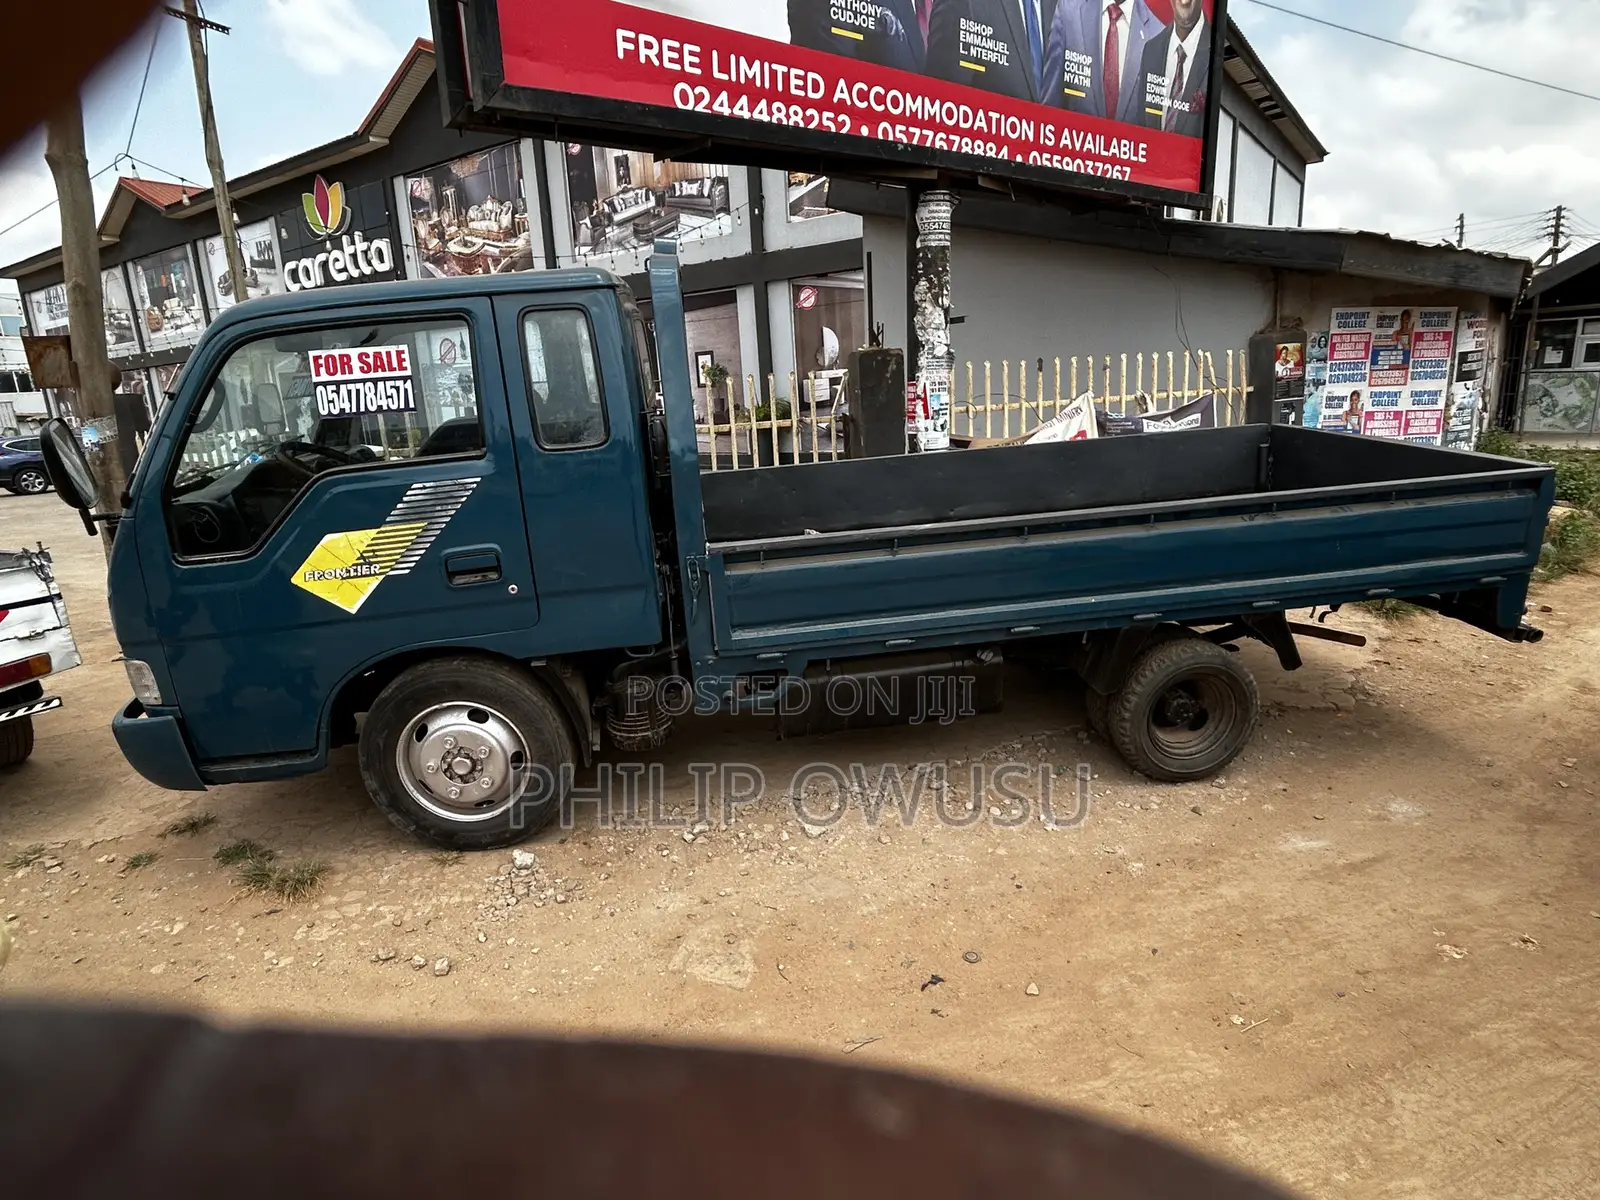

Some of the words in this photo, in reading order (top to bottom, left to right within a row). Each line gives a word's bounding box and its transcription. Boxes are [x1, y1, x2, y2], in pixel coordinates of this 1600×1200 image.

[830, 7, 876, 30] CUDJOE
[960, 18, 993, 37] BISHOP
[960, 31, 1009, 54] EMMANUEL
[960, 42, 968, 55] L.
[970, 46, 1009, 66] NTERFUL
[1065, 49, 1092, 66] BISHOP
[1064, 61, 1091, 77] COLLIN
[1063, 72, 1091, 88] NYATHI
[1147, 73, 1169, 87] BISHOP
[615, 28, 702, 75] FREE
[712, 49, 825, 100] LIMITED
[832, 77, 1034, 142] ACCOMMODATION
[1039, 122, 1056, 145] IS
[1060, 128, 1148, 163] AVAILABLE
[1146, 83, 1166, 96] EDWIN
[673, 82, 851, 135] 0244488252
[1145, 94, 1172, 107] MORGAN
[1336, 312, 1370, 320] ENDPOINT
[1337, 320, 1367, 328] COLLEGE
[1421, 319, 1449, 327] COLLEGE
[312, 354, 353, 377] FOR
[357, 350, 408, 374] SALE
[315, 379, 415, 416] 0547784571
[1411, 390, 1442, 398] ENDPOINT
[1371, 399, 1398, 407] COLLEGE
[304, 563, 380, 583] FRONTIER
